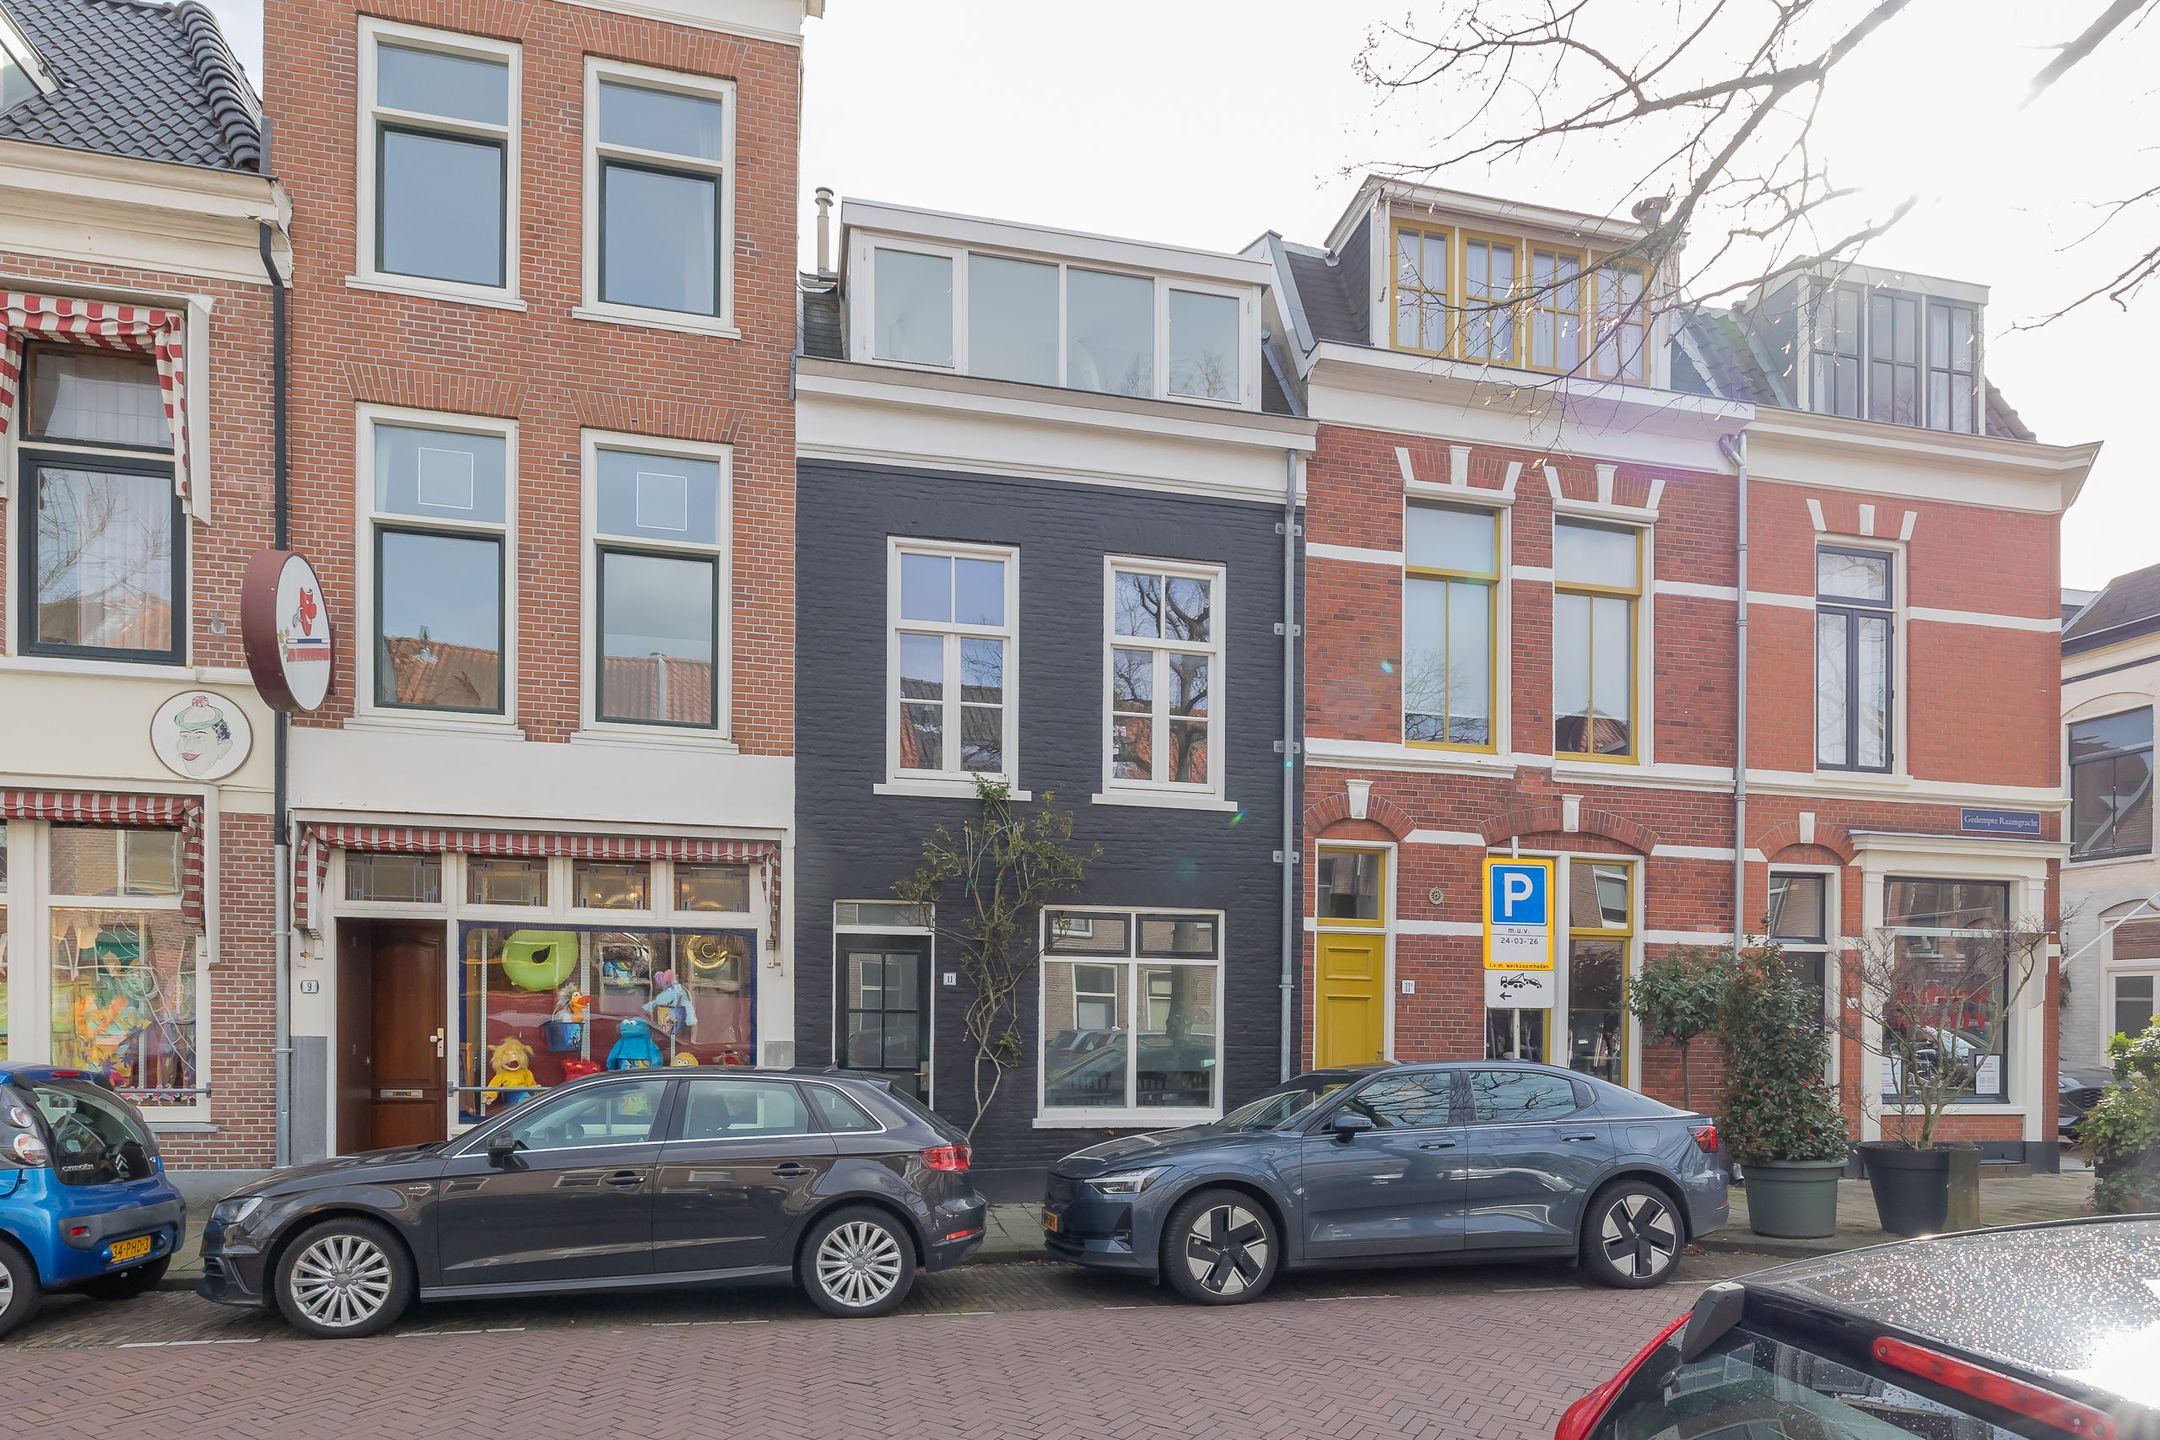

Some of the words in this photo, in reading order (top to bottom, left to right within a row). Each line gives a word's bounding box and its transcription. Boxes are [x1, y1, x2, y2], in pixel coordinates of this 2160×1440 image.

[1964, 815, 1998, 826] Gedempte
[1504, 873, 1533, 917] P
[307, 981, 312, 991] 9
